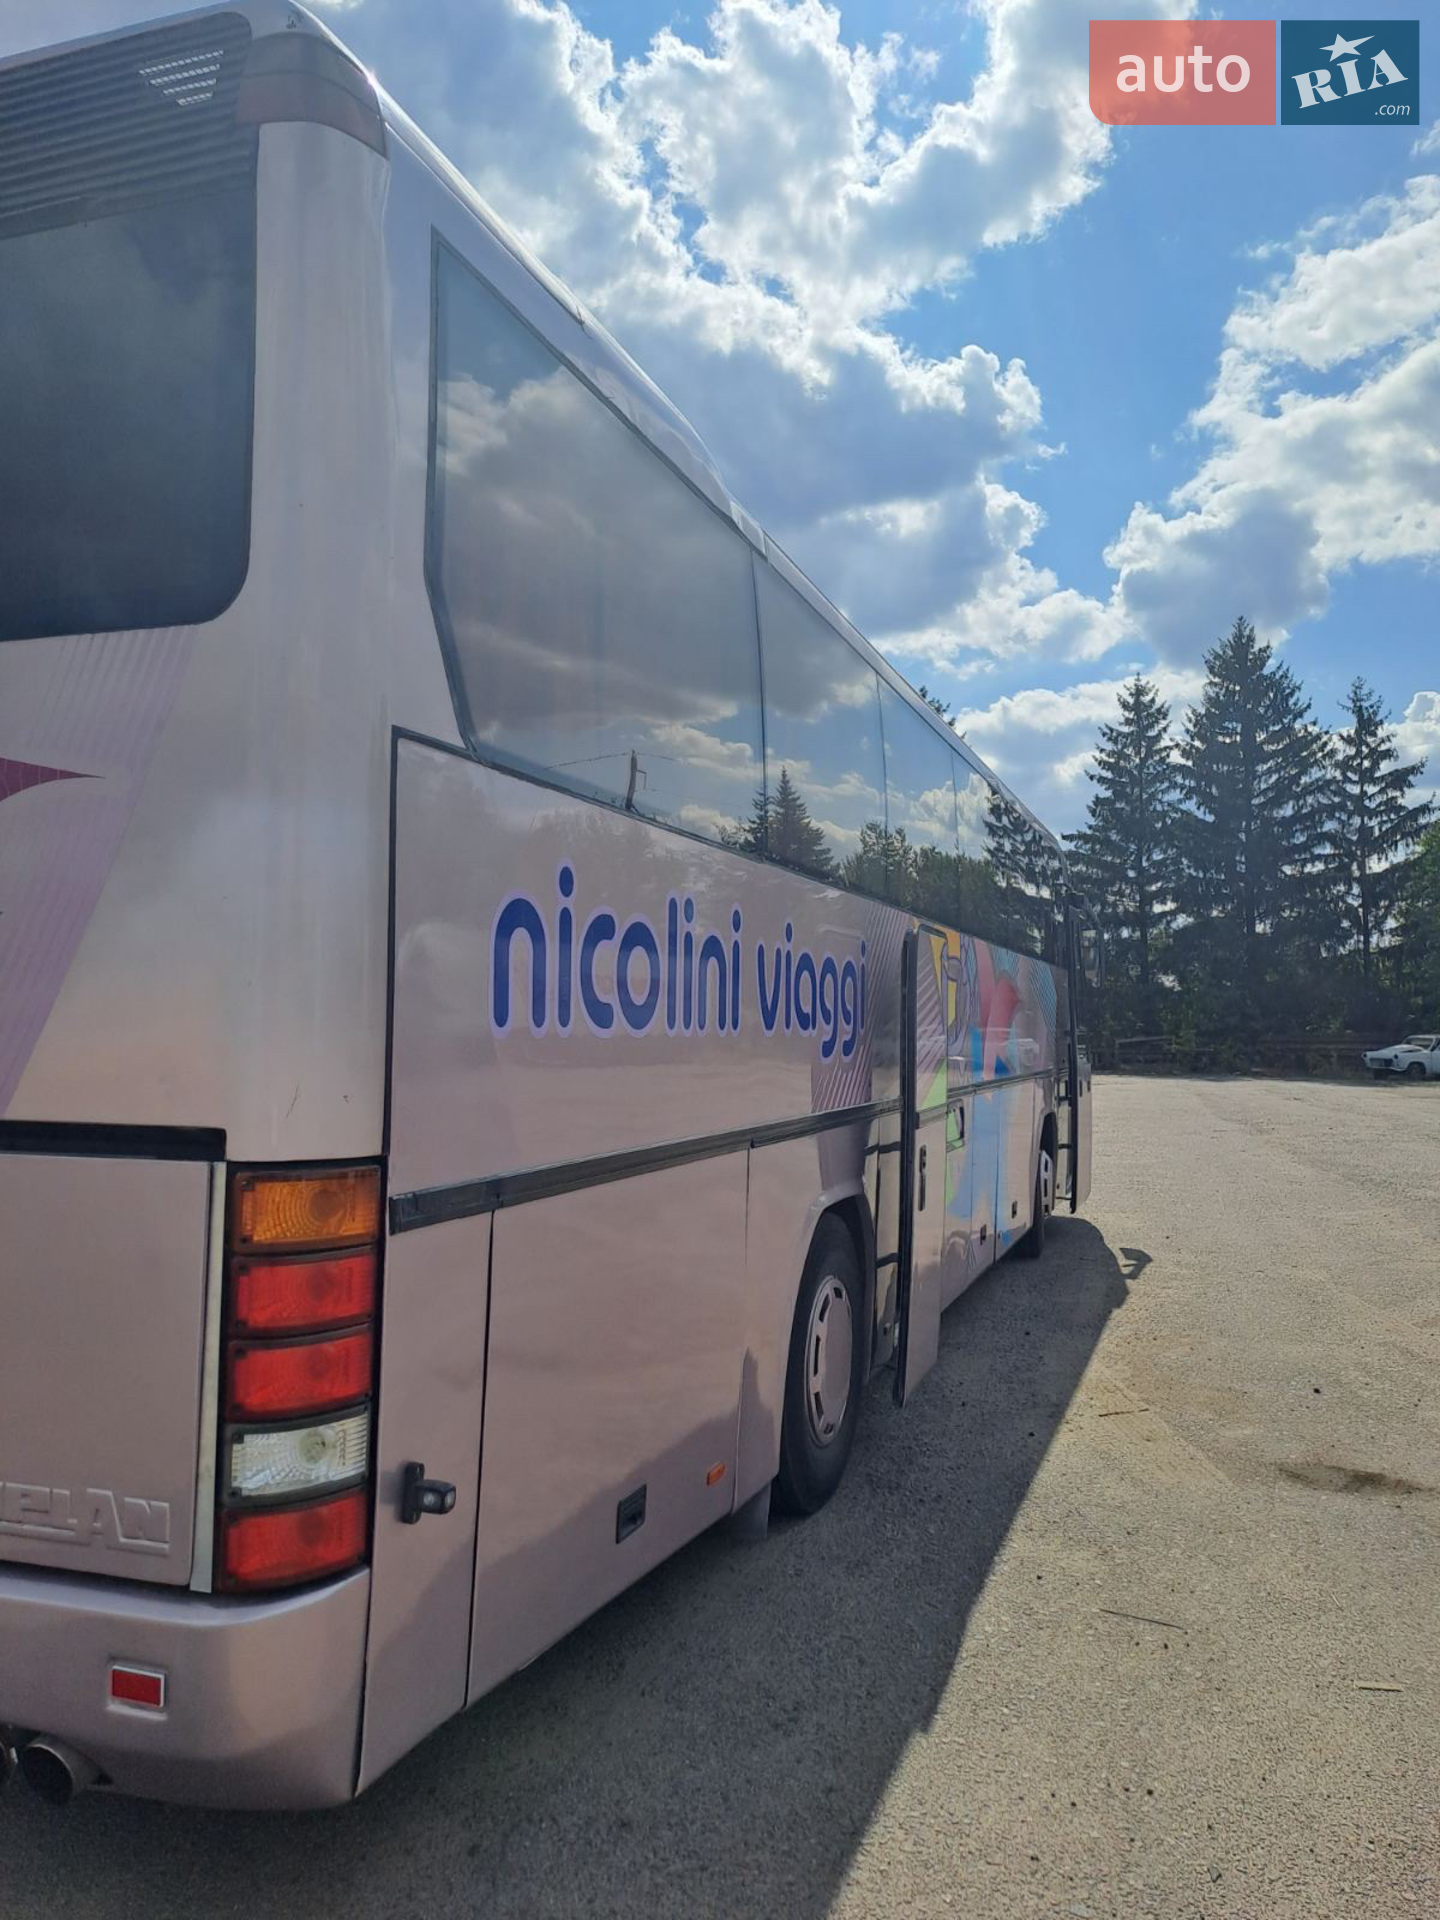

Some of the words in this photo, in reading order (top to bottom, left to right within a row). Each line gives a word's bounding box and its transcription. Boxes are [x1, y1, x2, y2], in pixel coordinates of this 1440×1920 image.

[491, 863, 743, 1033] nicolini
[756, 919, 867, 1060] viaggi
[0, 1480, 170, 1557] PLAN
